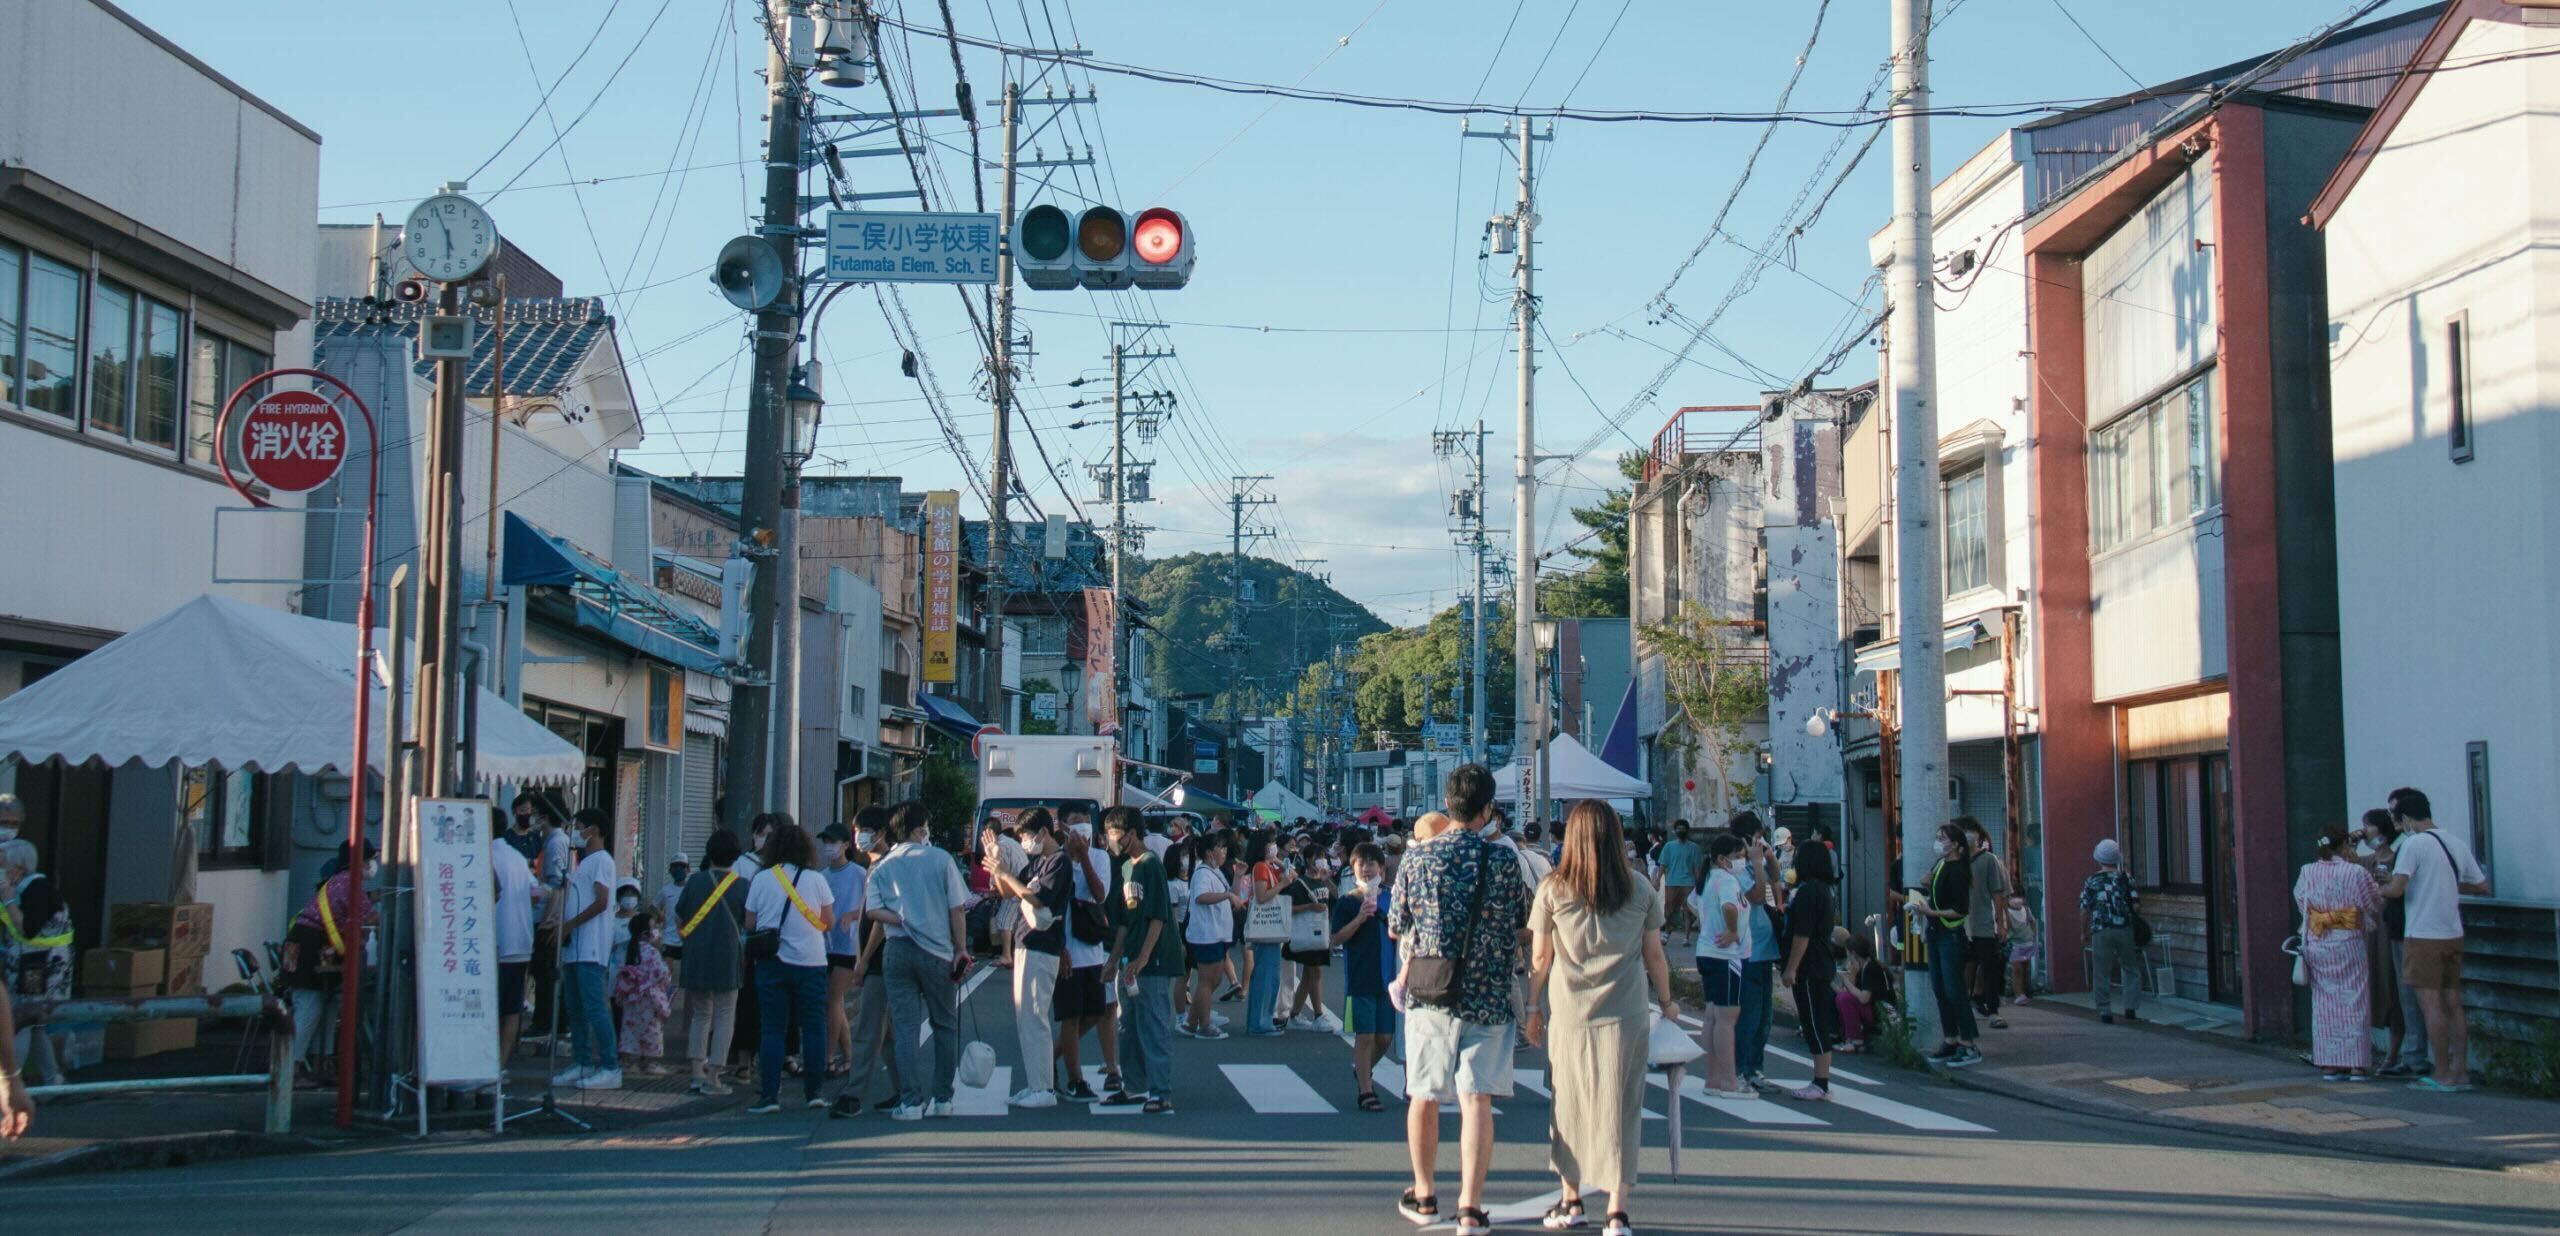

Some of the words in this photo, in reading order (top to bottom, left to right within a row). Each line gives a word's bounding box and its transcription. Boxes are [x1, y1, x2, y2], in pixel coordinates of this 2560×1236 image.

[444, 204, 456, 214] 12
[463, 208, 467, 218] 1
[417, 218, 430, 229] 10
[471, 219, 480, 230] 2
[414, 232, 422, 243] 9
[474, 234, 483, 244] 3
[835, 222, 992, 253] 二俣小学校東
[417, 247, 425, 258] 8
[471, 248, 478, 258] 4
[430, 258, 436, 269] 7
[443, 262, 452, 272] 6
[459, 258, 467, 269] 5
[832, 255, 895, 272] Futamata
[901, 256, 939, 274] Elem.
[945, 257, 974, 274] Sch.
[260, 403, 281, 414] FIRE
[284, 403, 329, 414] HYDRANT
[250, 421, 339, 460] 消火栓
[931, 505, 951, 632] 小学館の学習雑誌
[438, 863, 457, 973] 浴衣でフェスタ
[460, 853, 481, 976] フェスタ天竜
